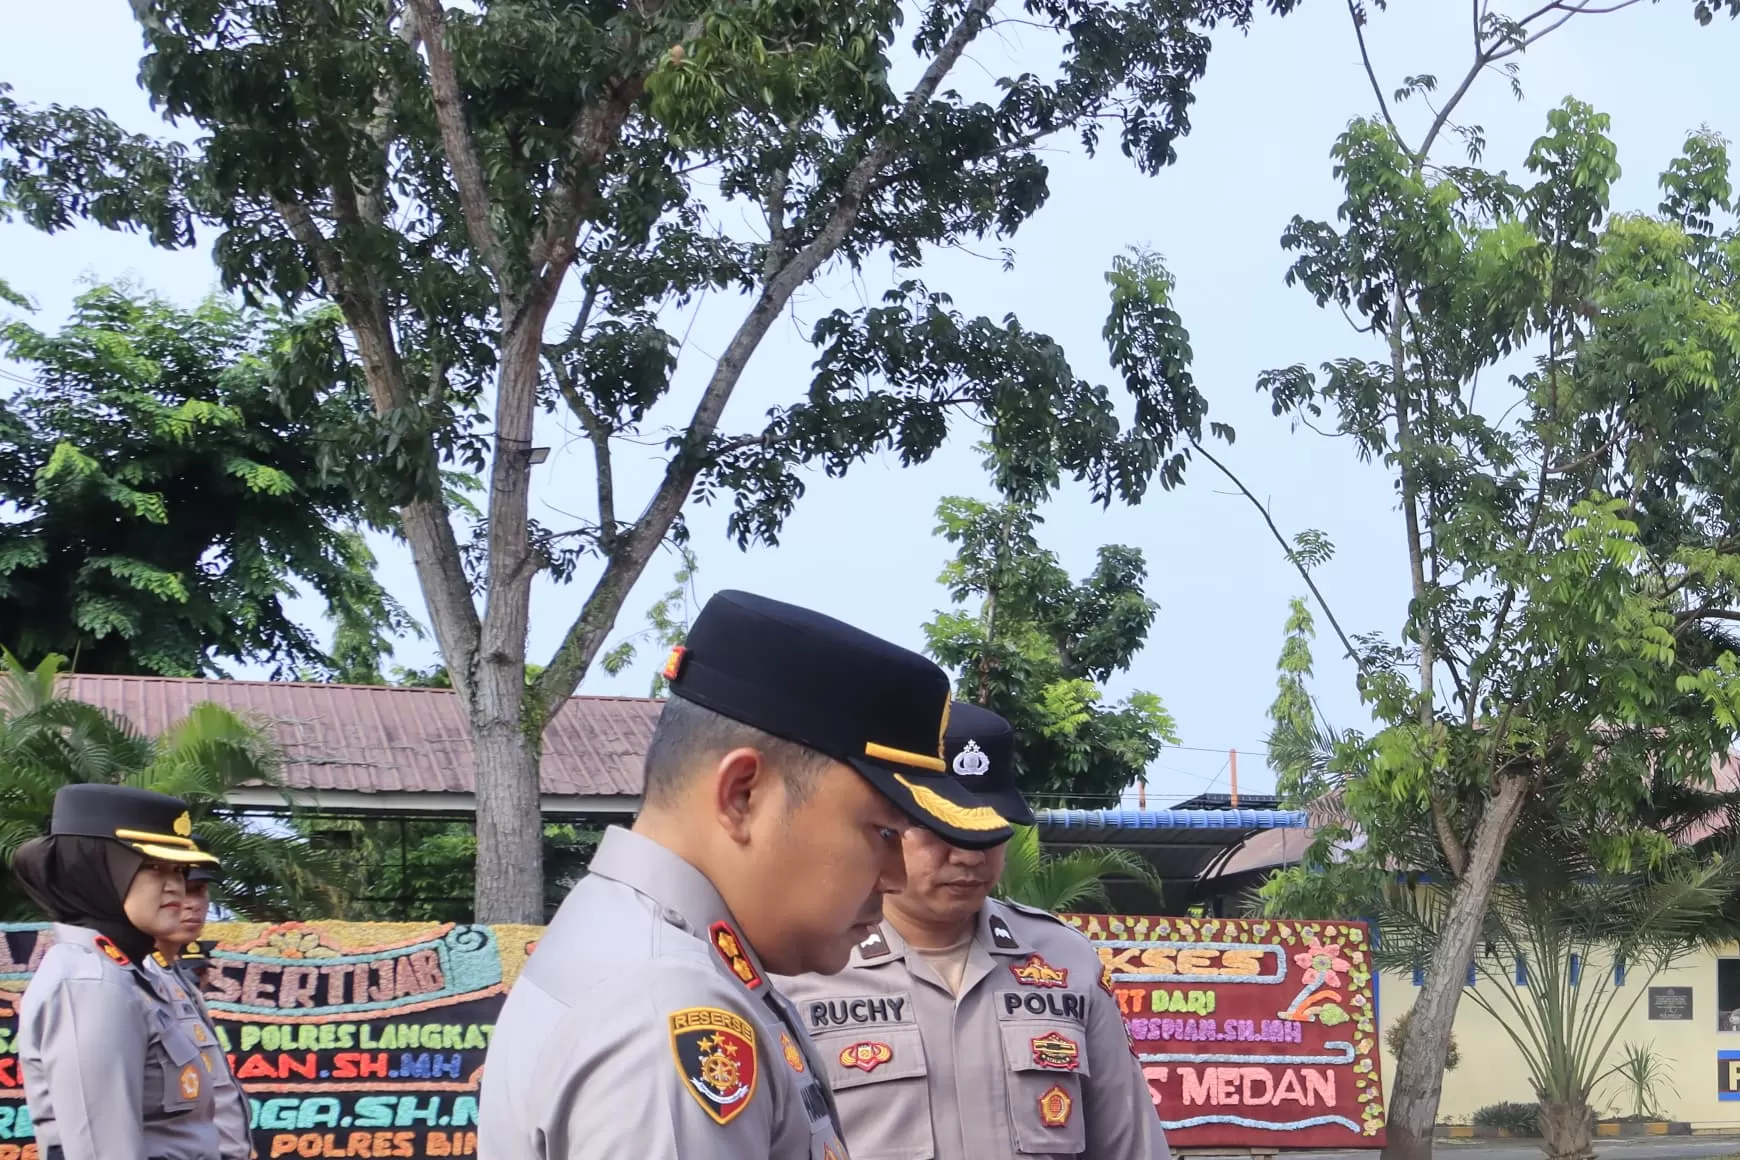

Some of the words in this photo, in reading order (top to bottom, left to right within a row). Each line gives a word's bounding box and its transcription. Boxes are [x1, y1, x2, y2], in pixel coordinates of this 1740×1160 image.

[203, 949, 445, 1009] SERTIJAB
[810, 997, 906, 1027] RUCHY
[1004, 992, 1086, 1020] POLRI
[1151, 989, 1216, 1017] DARI
[240, 1023, 356, 1051] POLRES
[359, 1023, 498, 1050] LANGKAT
[674, 1011, 753, 1041] RESERSE
[1176, 1067, 1336, 1107] MEDAN
[269, 1131, 417, 1158] POLRES
